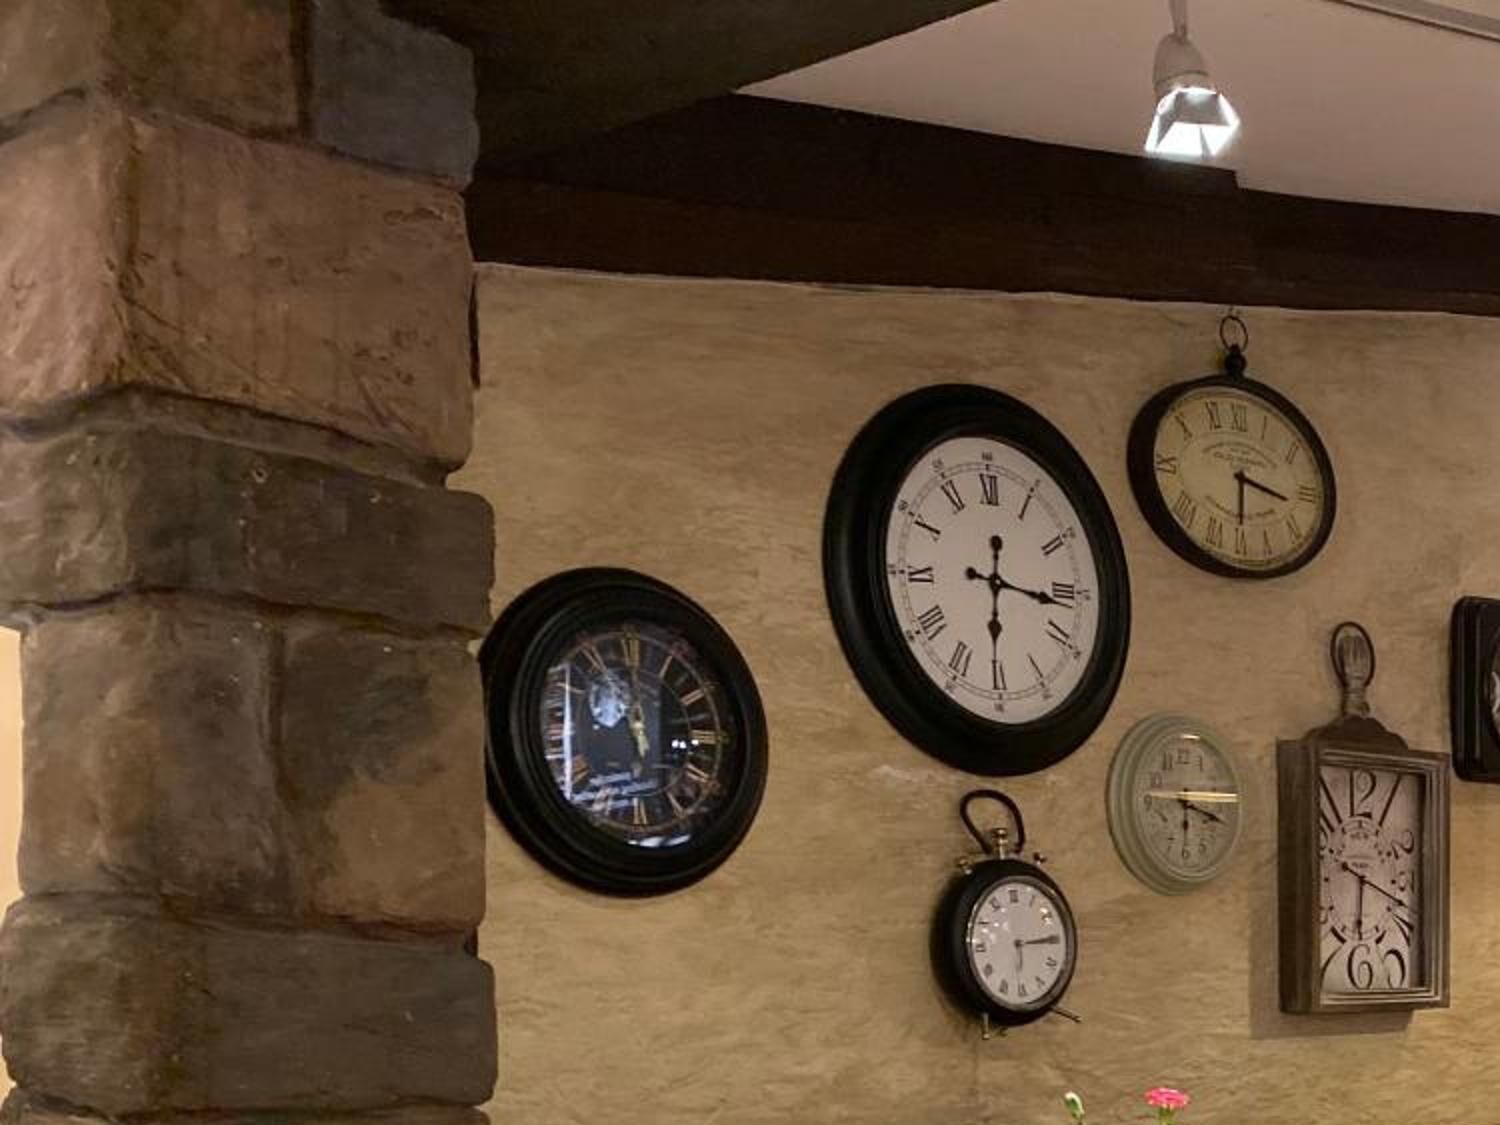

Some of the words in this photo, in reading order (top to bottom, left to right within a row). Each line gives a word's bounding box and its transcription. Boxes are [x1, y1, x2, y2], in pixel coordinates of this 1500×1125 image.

[1231, 402, 1248, 432] XII
[940, 479, 966, 514] XI
[979, 473, 1000, 506] XII
[1041, 534, 1064, 556] II
[907, 565, 934, 583] IX
[1348, 767, 1376, 819] 12
[1378, 772, 1403, 828] 1
[1347, 944, 1374, 990] 6
